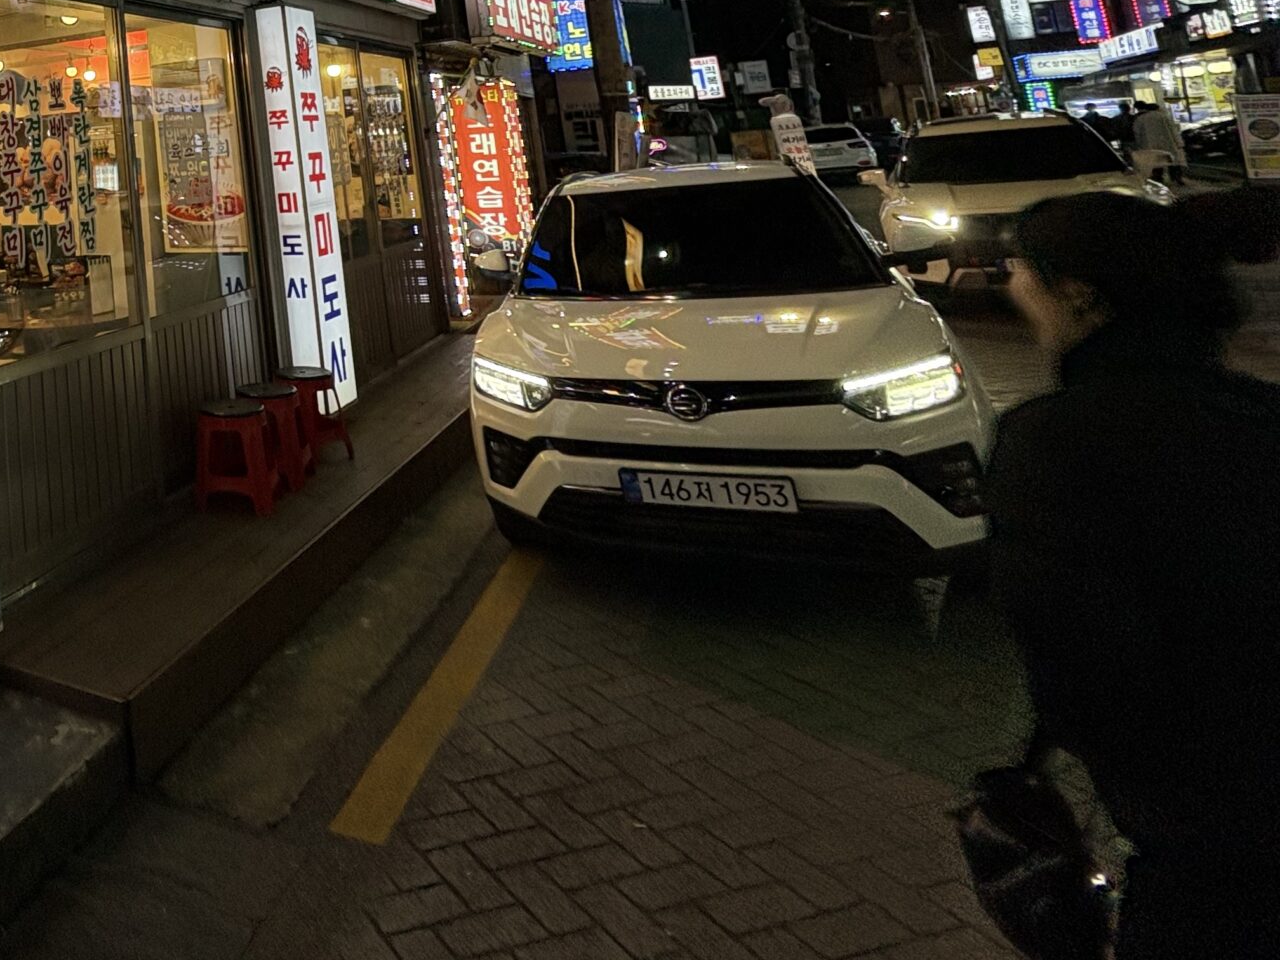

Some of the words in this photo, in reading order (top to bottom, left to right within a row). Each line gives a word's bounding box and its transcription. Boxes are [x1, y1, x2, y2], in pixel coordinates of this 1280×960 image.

[48, 77, 76, 255] 뽀빠이육전
[268, 109, 308, 299] 쭈꾸미도사
[301, 92, 348, 383] 쭈꾸미도사
[643, 477, 714, 503] 146저
[721, 481, 789, 508] 1953
